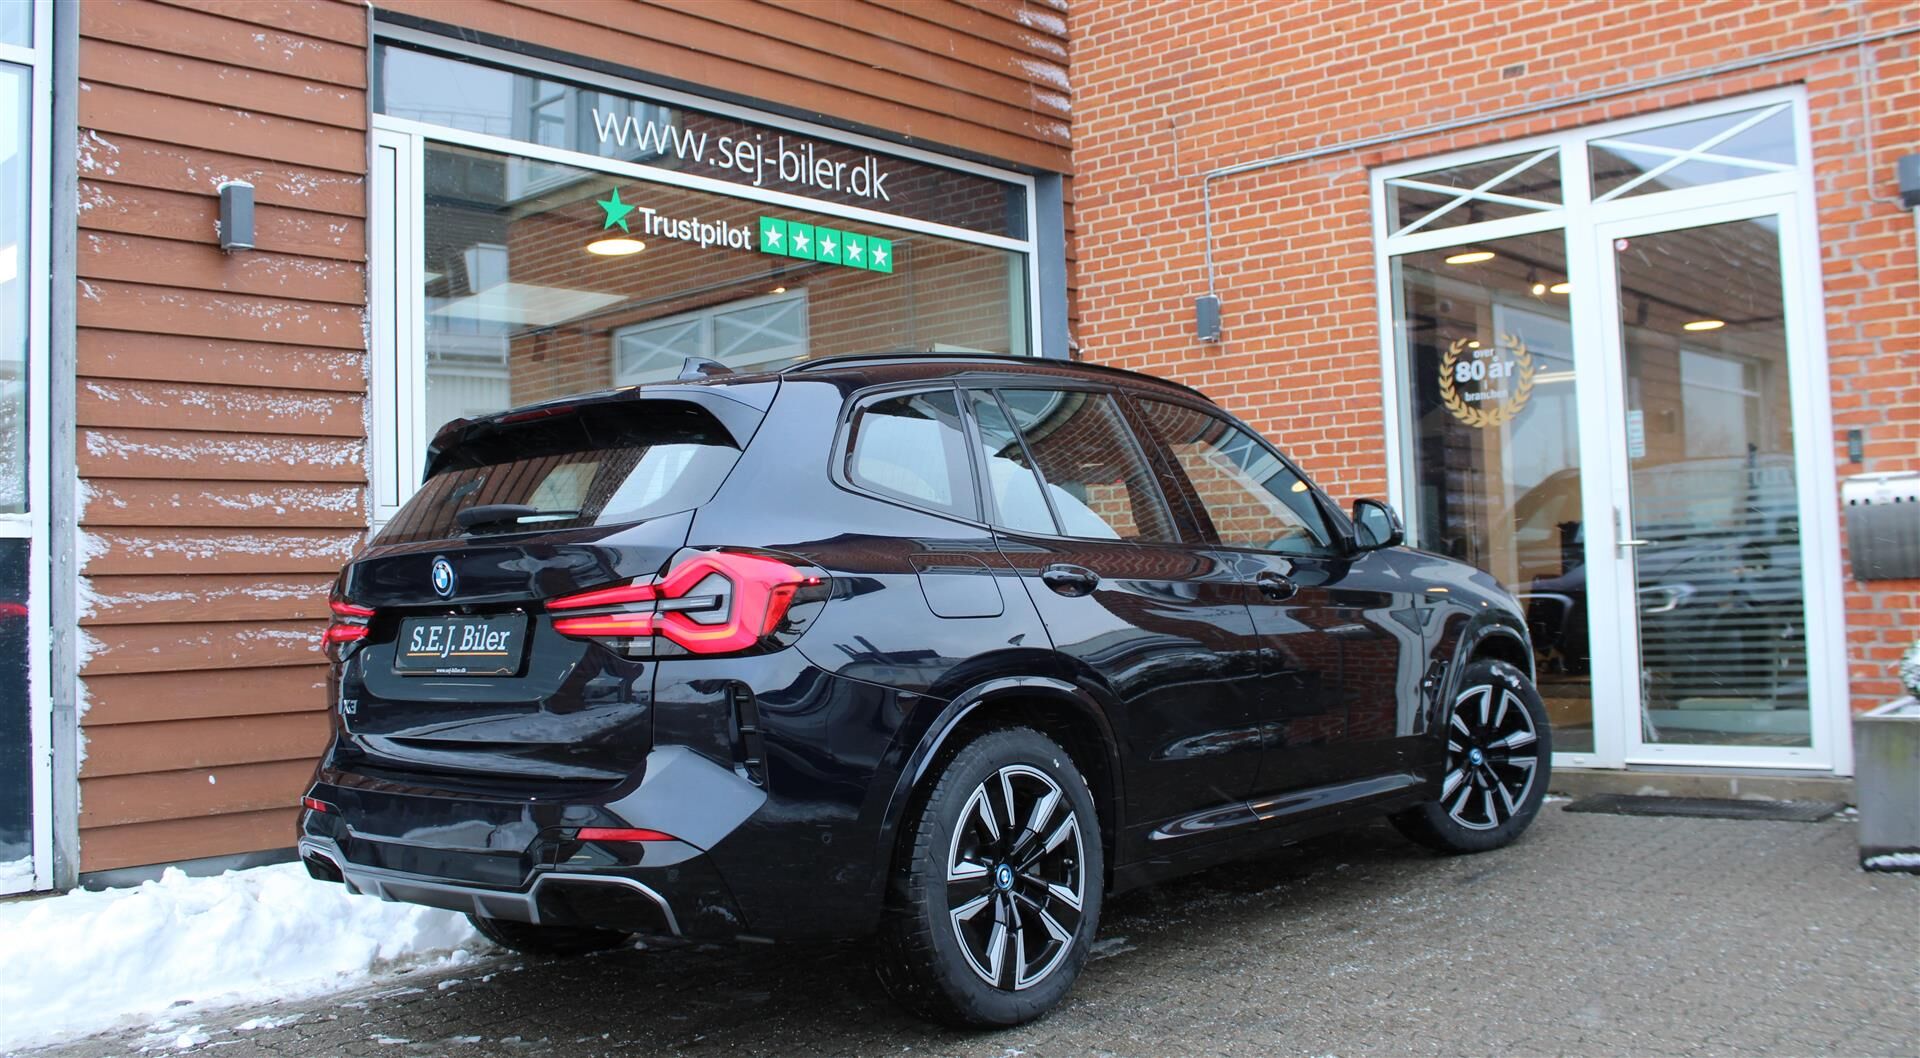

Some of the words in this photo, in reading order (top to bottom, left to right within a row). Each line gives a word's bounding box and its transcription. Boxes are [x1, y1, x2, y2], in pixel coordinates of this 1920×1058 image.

[592, 108, 890, 202] www.sej-biler.dk
[638, 206, 752, 250] Trustpilot
[1455, 360, 1486, 383] 80
[1488, 355, 1515, 379] år
[1473, 348, 1495, 359] over
[410, 625, 456, 658] S.E.J.
[459, 624, 511, 651] Biler
